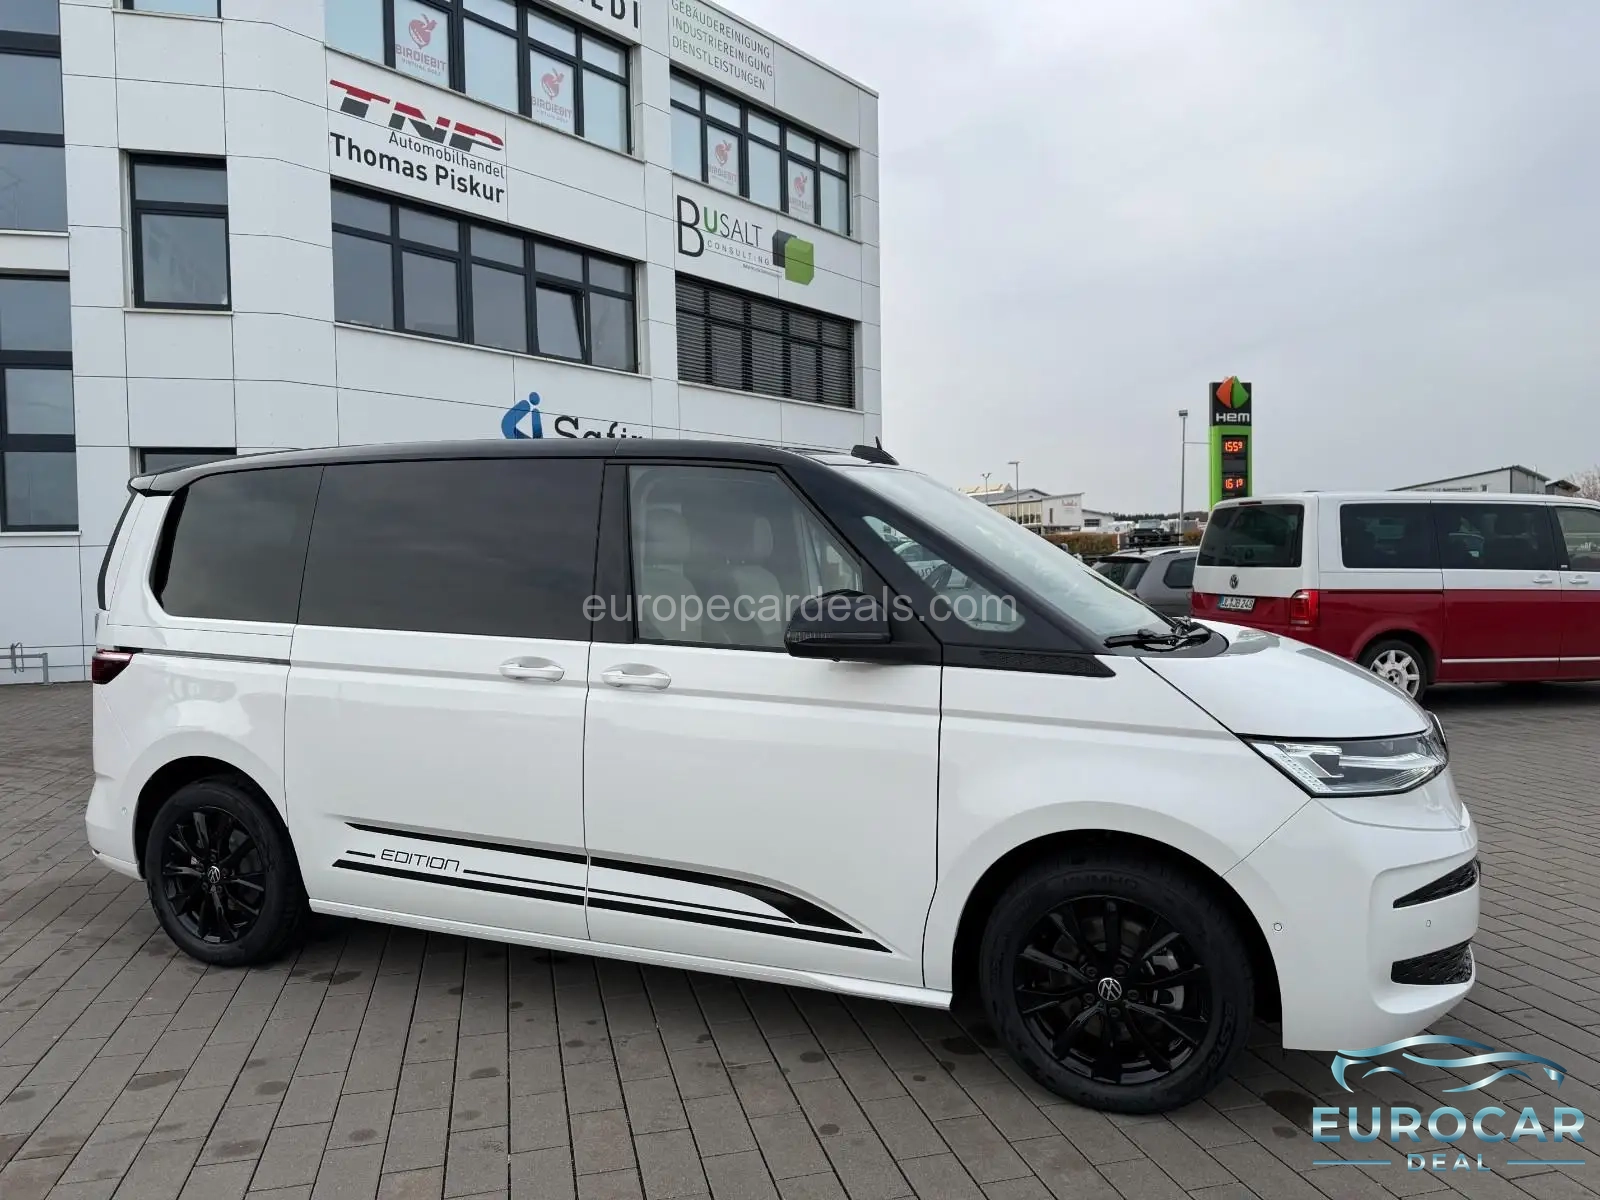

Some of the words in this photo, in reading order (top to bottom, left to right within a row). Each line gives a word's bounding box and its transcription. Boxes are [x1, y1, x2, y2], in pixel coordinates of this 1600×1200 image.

[580, 0, 639, 29] DI
[671, 0, 770, 59] GEBÄUDEREINIGUNG
[395, 44, 448, 72] BIRDIEBIT
[672, 15, 774, 77] INDUSTRIEREINIGUNG
[672, 35, 766, 90] DIENSTLEISTUNGEN
[329, 131, 429, 181] Thomas
[435, 164, 506, 203] Piskur
[388, 131, 505, 179] Automobilhandel
[707, 239, 770, 266] CONSULTING
[380, 848, 460, 872] EDITION
